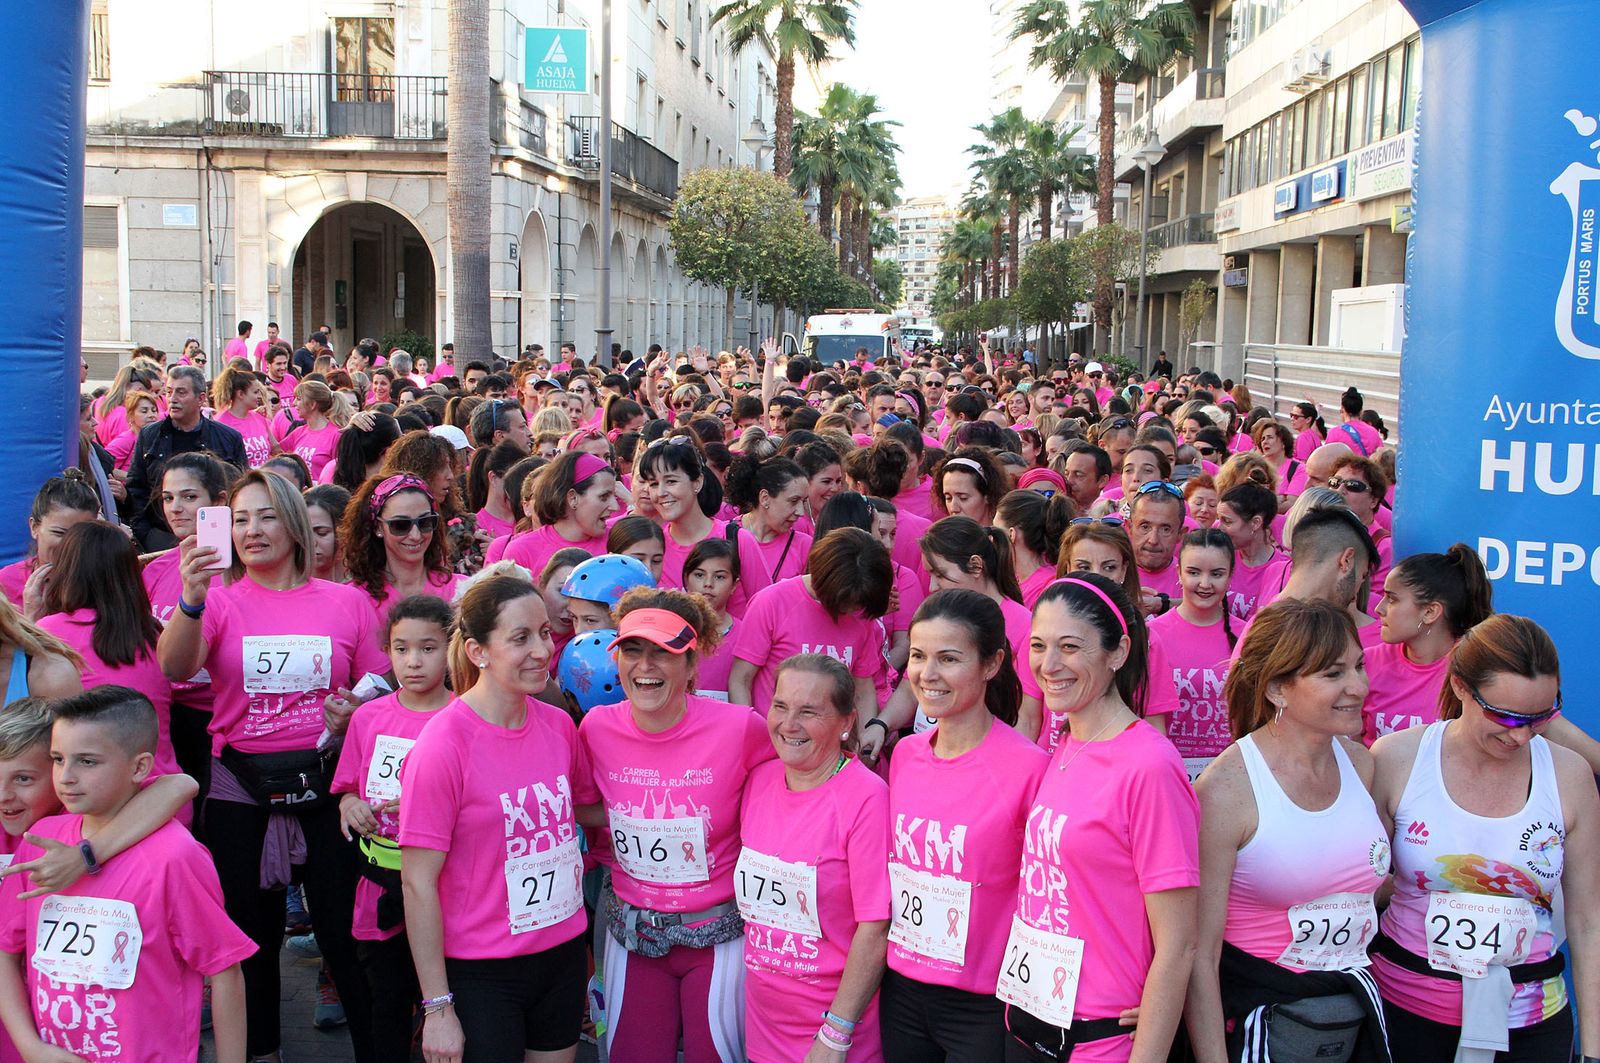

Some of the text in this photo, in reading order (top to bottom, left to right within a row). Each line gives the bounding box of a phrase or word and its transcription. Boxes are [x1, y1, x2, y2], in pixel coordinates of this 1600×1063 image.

[536, 66, 576, 79] ASAJA
[536, 78, 577, 89] HUELVA
[1360, 138, 1406, 171] PREVENTIVA
[1374, 167, 1405, 192] SEGUROS
[1575, 208, 1595, 315] PORTUS MARIS
[1479, 439, 1600, 495] HU
[1478, 536, 1600, 586] DEP
[256, 651, 291, 675] 57
[1168, 720, 1232, 739] ELLAS
[1375, 712, 1423, 739] K
[608, 771, 713, 788] DE LA MUJER & RUNNING
[622, 766, 713, 778] CARRERA PINK
[270, 789, 318, 805] FILA
[499, 774, 573, 838] KM
[650, 824, 661, 832] de
[663, 825, 672, 833] la
[673, 825, 697, 834] Mujer
[1404, 837, 1428, 846] mobel
[1519, 821, 1543, 852] DIOSAS
[614, 829, 668, 863] 816
[895, 813, 968, 874] KM
[521, 859, 551, 871] Carrera
[552, 854, 561, 863] de
[748, 857, 770, 872] Carrera
[771, 866, 780, 875] de
[780, 869, 787, 877] la
[789, 871, 810, 883] Mujer
[521, 870, 556, 907] 27
[739, 870, 787, 906] 175
[920, 882, 930, 891] de
[931, 883, 939, 893] la
[941, 887, 966, 899] Mujer
[55, 902, 86, 914] Carrera
[87, 906, 99, 915] de
[100, 907, 109, 917] la
[901, 889, 923, 927] 28
[1305, 902, 1339, 911] Carrera
[1449, 899, 1484, 913] Carrera
[1487, 904, 1501, 914] de
[1503, 905, 1512, 915] la
[42, 919, 98, 957] 725
[1295, 916, 1352, 946] 316
[1431, 914, 1502, 955] 234
[1040, 940, 1048, 950] la
[1050, 943, 1077, 957] Mujer
[771, 958, 781, 966] de
[783, 960, 791, 968] la
[794, 962, 819, 973] Mujer
[1006, 944, 1031, 984] 26
[37, 985, 118, 1030] POR
